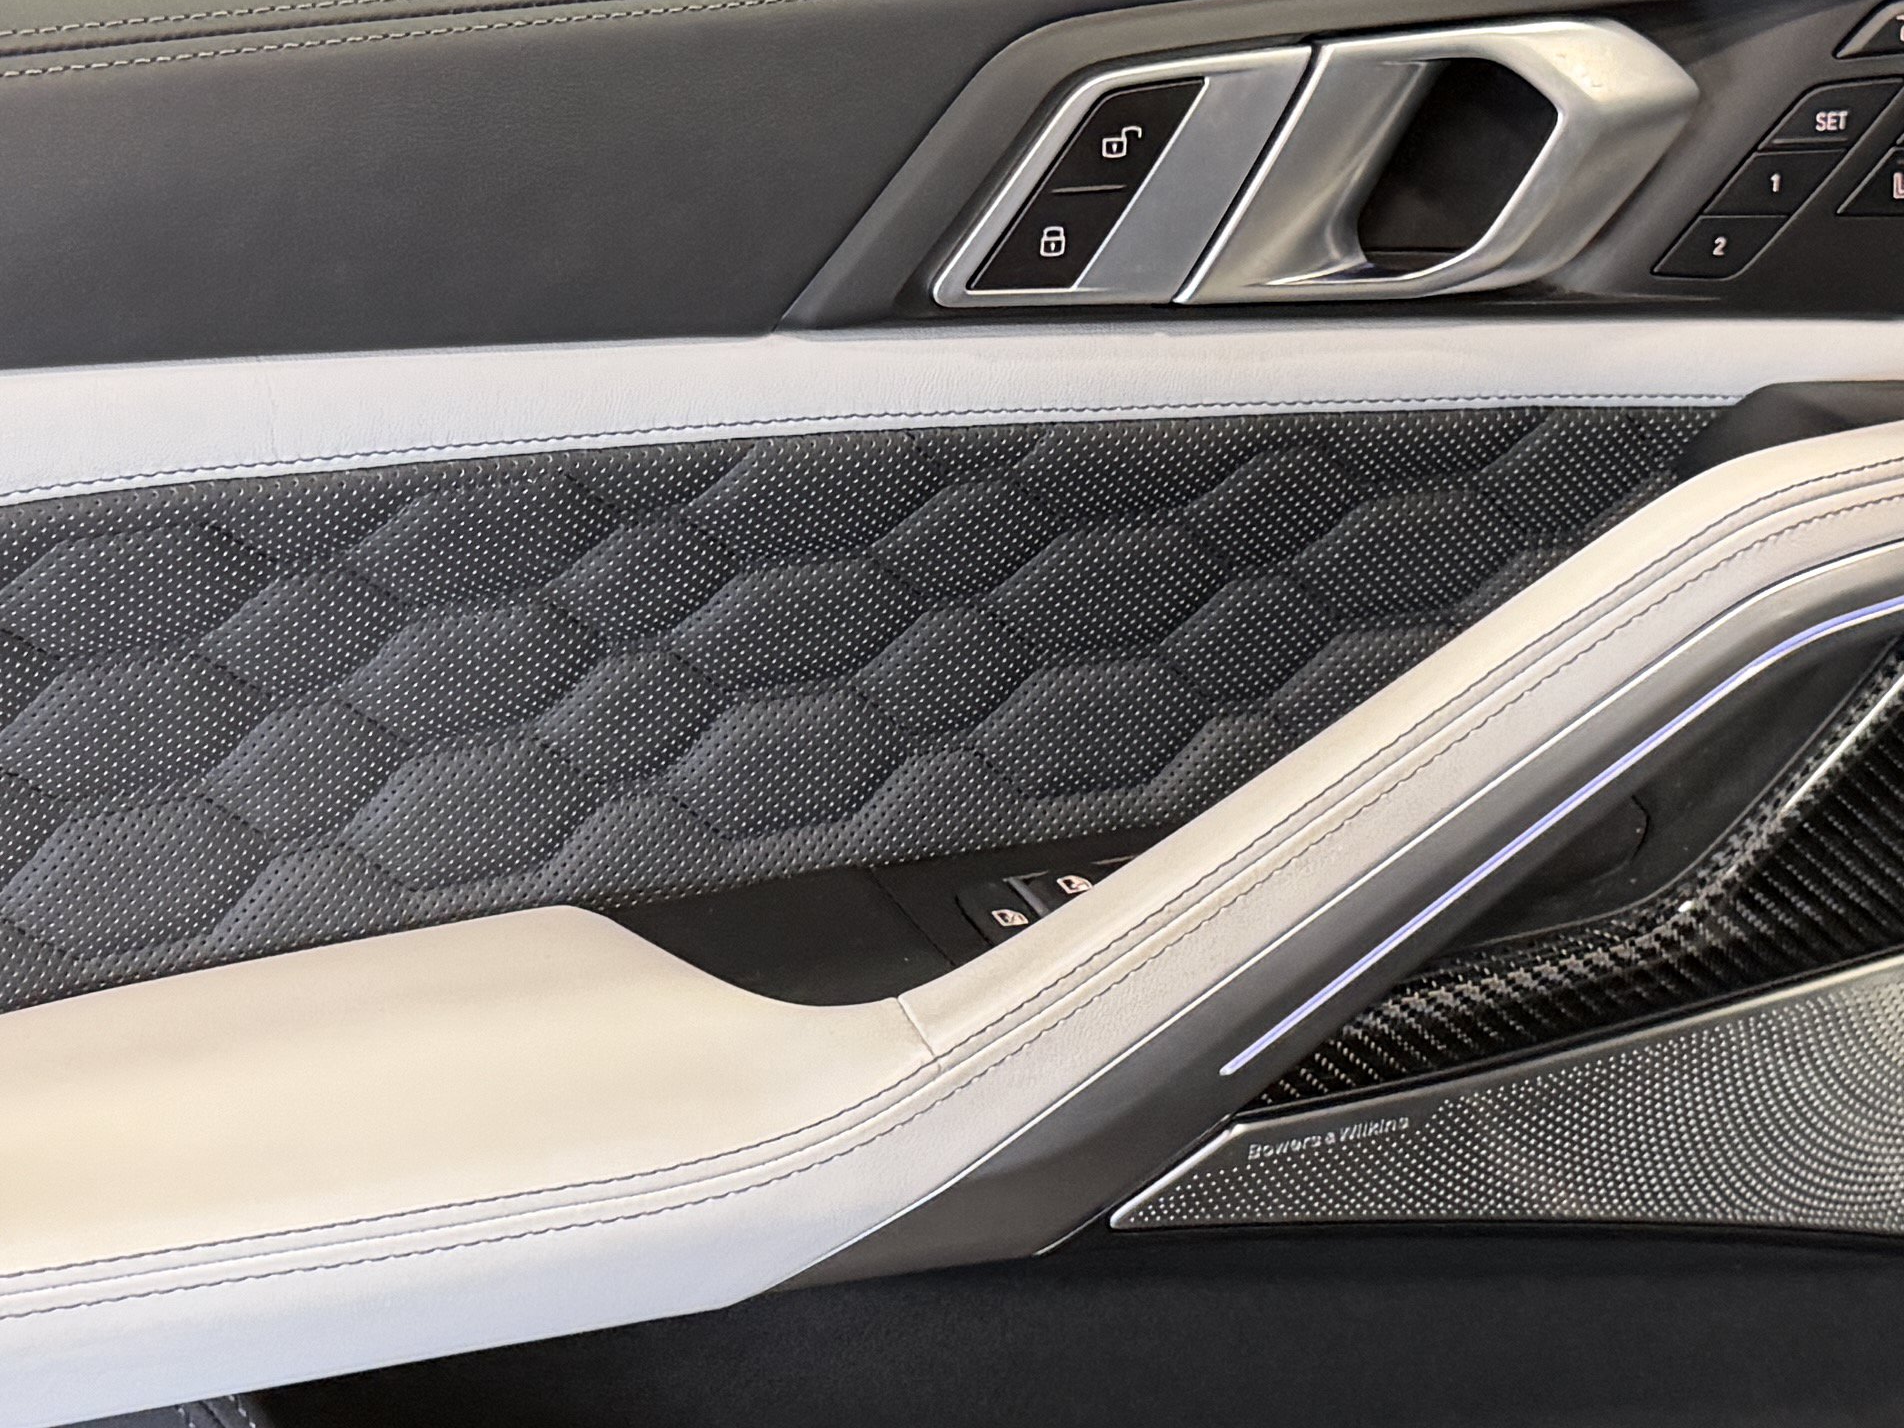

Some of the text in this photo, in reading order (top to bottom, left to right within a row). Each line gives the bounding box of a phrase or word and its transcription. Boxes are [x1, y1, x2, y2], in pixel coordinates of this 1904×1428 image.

[1815, 110, 1848, 132] SET
[1770, 173, 1781, 193] 1
[1712, 236, 1727, 257] 2
[1247, 1135, 1322, 1161] Bowers
[1339, 1116, 1411, 1142] Wilkins
